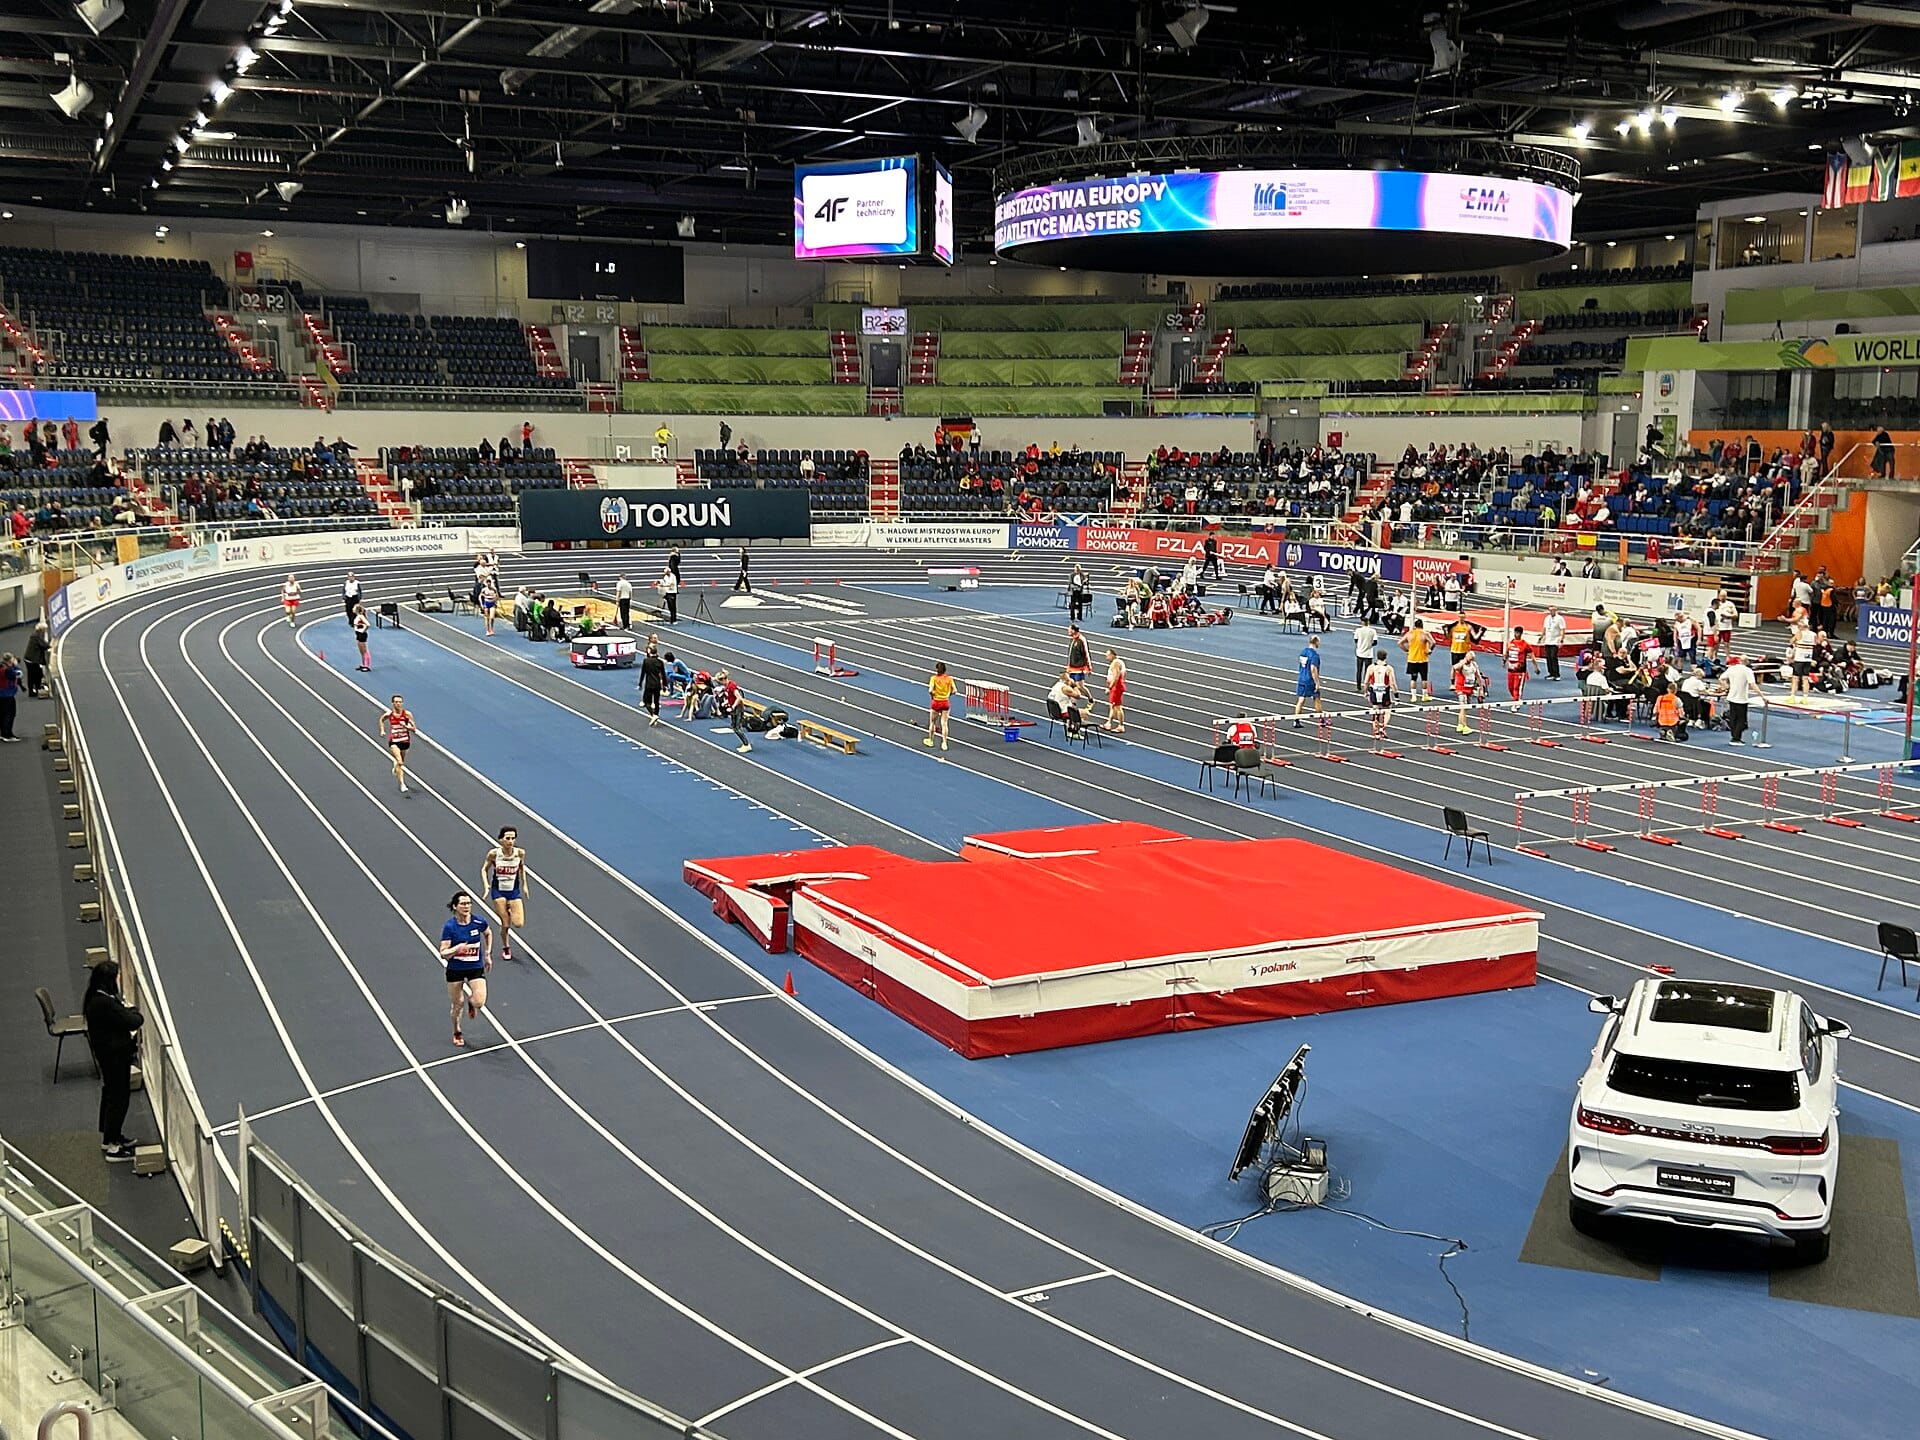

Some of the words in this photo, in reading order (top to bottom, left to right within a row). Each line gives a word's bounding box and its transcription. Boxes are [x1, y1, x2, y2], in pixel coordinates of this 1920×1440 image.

[856, 200, 884, 208] Partner
[1003, 189, 1087, 219] MISTRZOSTWA
[1089, 182, 1167, 206] EUROPY
[1465, 187, 1506, 212] EMA
[856, 208, 896, 217] techniczny
[1006, 216, 1057, 242] ATLETYCE
[1059, 208, 1142, 233] MASTERS
[266, 295, 284, 309] P2
[1468, 304, 1485, 318] T2
[1166, 313, 1183, 326] S2
[1854, 338, 1920, 361] WORL
[616, 445, 631, 459] P1
[629, 497, 731, 527] TORUŃ
[214, 530, 231, 544] O1
[353, 535, 389, 544] EUROPEAN
[390, 534, 421, 542] MASTERS
[422, 533, 459, 541] ATHLETICS
[1016, 526, 1061, 538] KUJAWY
[1086, 529, 1130, 541] KUJAWY
[1313, 525, 1328, 539] T1
[1440, 529, 1459, 545] VIP
[359, 544, 415, 554] CHAMPIONSHIPS
[416, 543, 443, 551] INDOOR
[1016, 537, 1069, 548] POMORZE
[1086, 540, 1138, 552] POMORZE
[1156, 537, 1206, 554] PZLA
[225, 545, 249, 562] EMA
[1221, 542, 1269, 560] PZLA
[1318, 551, 1382, 576] TORUŃ
[1413, 559, 1452, 572] KUJAWY
[1315, 578, 1322, 588] 3
[1869, 610, 1913, 628] KUJAW
[1867, 626, 1913, 643] POMO
[1260, 960, 1297, 976] polanik
